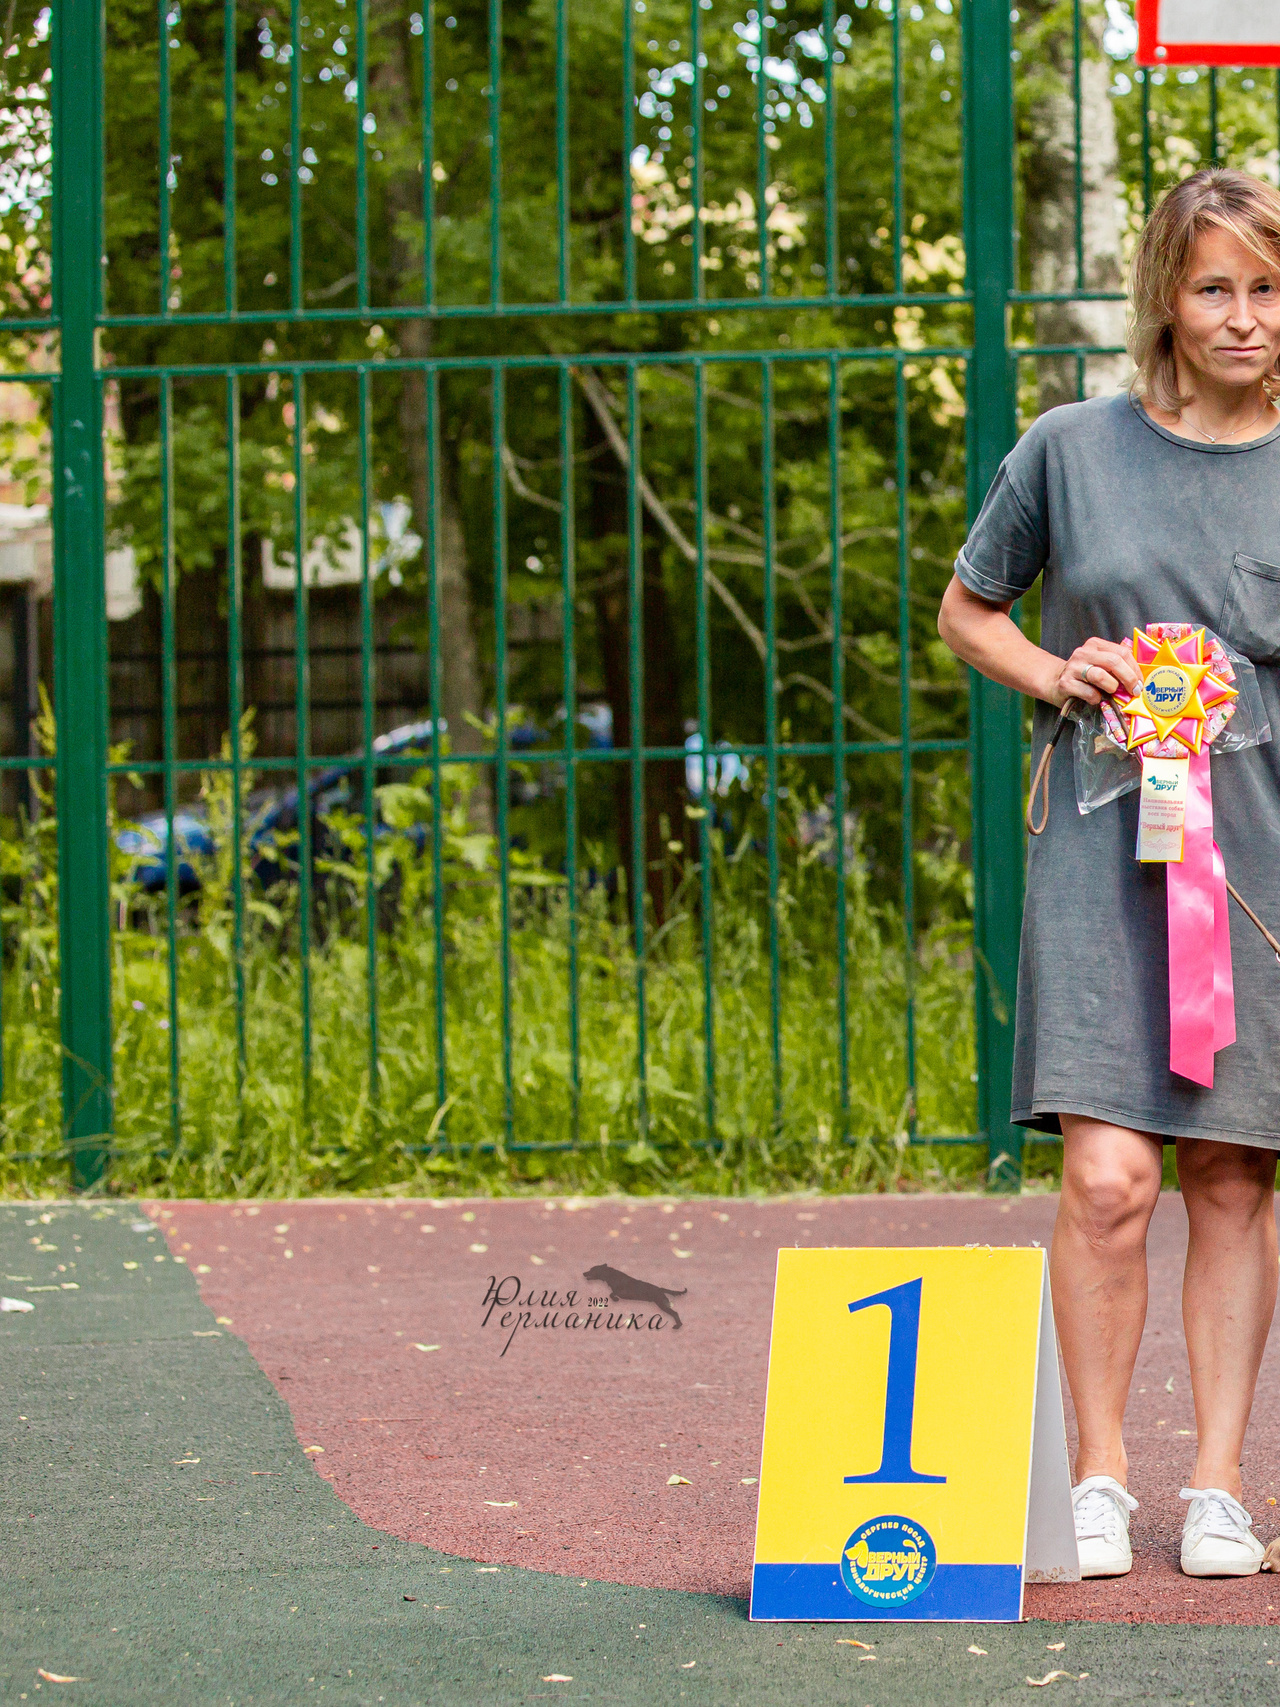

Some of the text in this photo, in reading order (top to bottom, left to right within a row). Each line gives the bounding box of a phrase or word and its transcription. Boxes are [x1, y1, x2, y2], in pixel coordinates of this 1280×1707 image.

[1154, 693, 1182, 702] ДРУГ
[843, 1276, 948, 1484] 1
[860, 1521, 926, 1548] СЕРГИЕВ ПОСАД
[849, 1555, 928, 1600] КИНОЛОГИЧЕСКИЙ ЦЕНТР
[861, 1563, 921, 1582] ДРУГ
